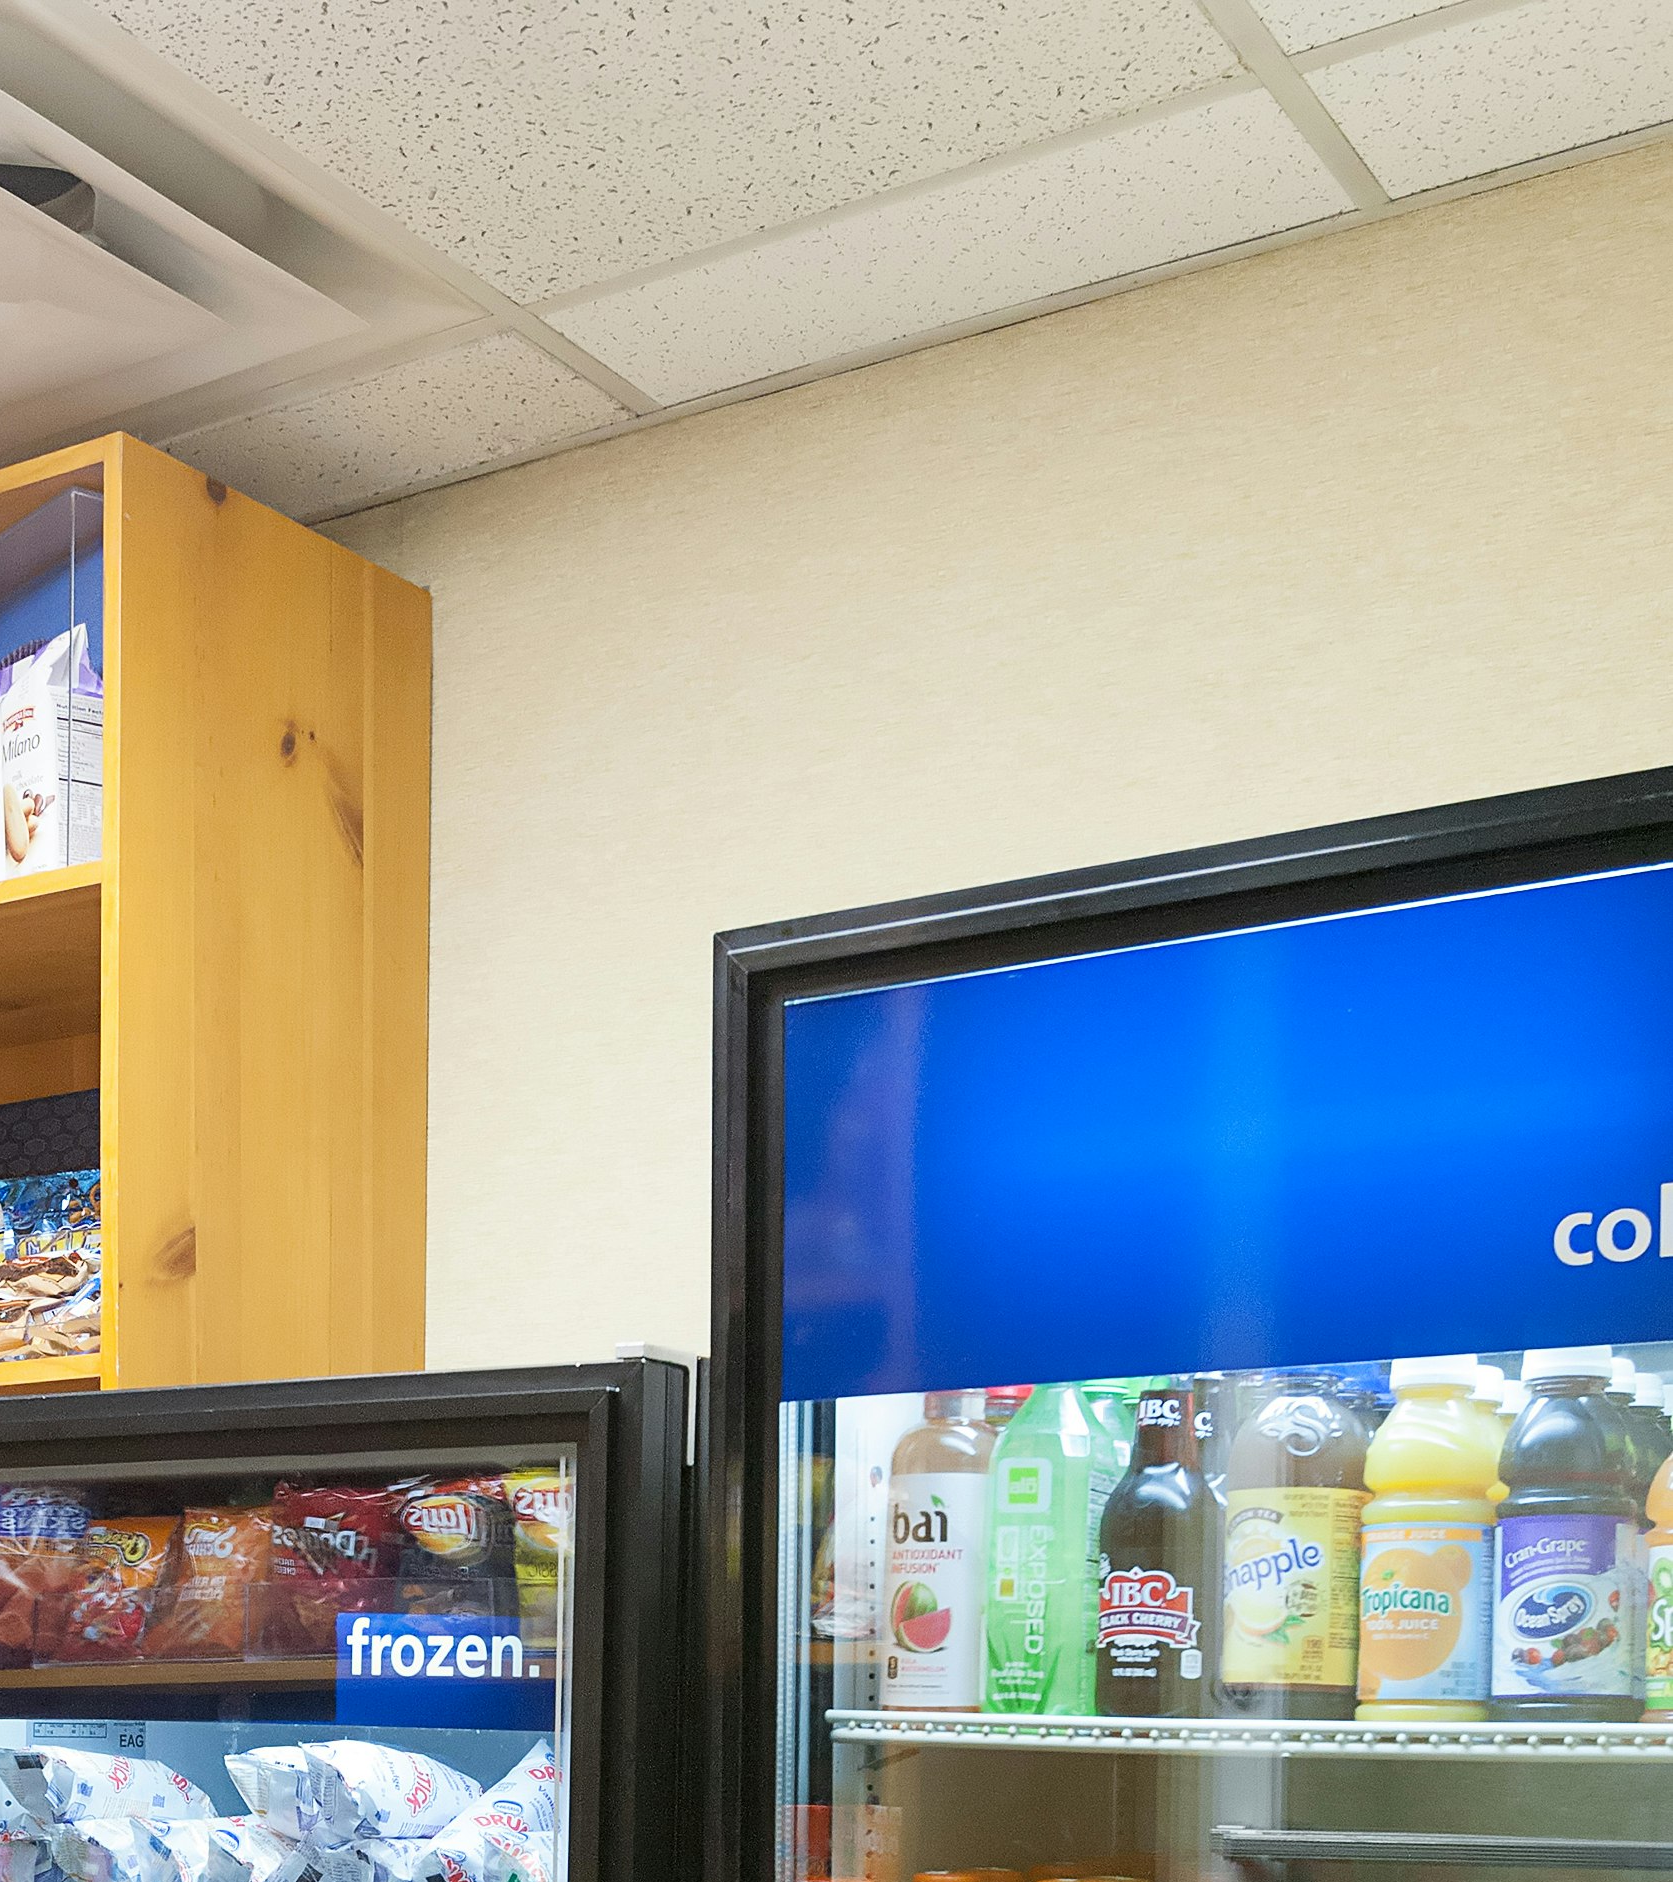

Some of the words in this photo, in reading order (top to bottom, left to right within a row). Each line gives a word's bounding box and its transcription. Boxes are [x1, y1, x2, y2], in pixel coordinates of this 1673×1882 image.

[1139, 1398, 1182, 1418] IBC
[891, 1497, 950, 1544] bai
[891, 1549, 964, 1562] ANTIOXIDANT
[1504, 1537, 1589, 1570] Cran-Grape
[1110, 1580, 1166, 1608] IBC
[1361, 1582, 1452, 1620] Tropicana
[1132, 1610, 1184, 1630] CHERRY
[1397, 1618, 1440, 1632] JUICE
[1514, 1606, 1551, 1631] Ocean
[1549, 1593, 1588, 1630] Spray
[346, 1616, 541, 1679] frozen.
[118, 1734, 145, 1749] EAG
